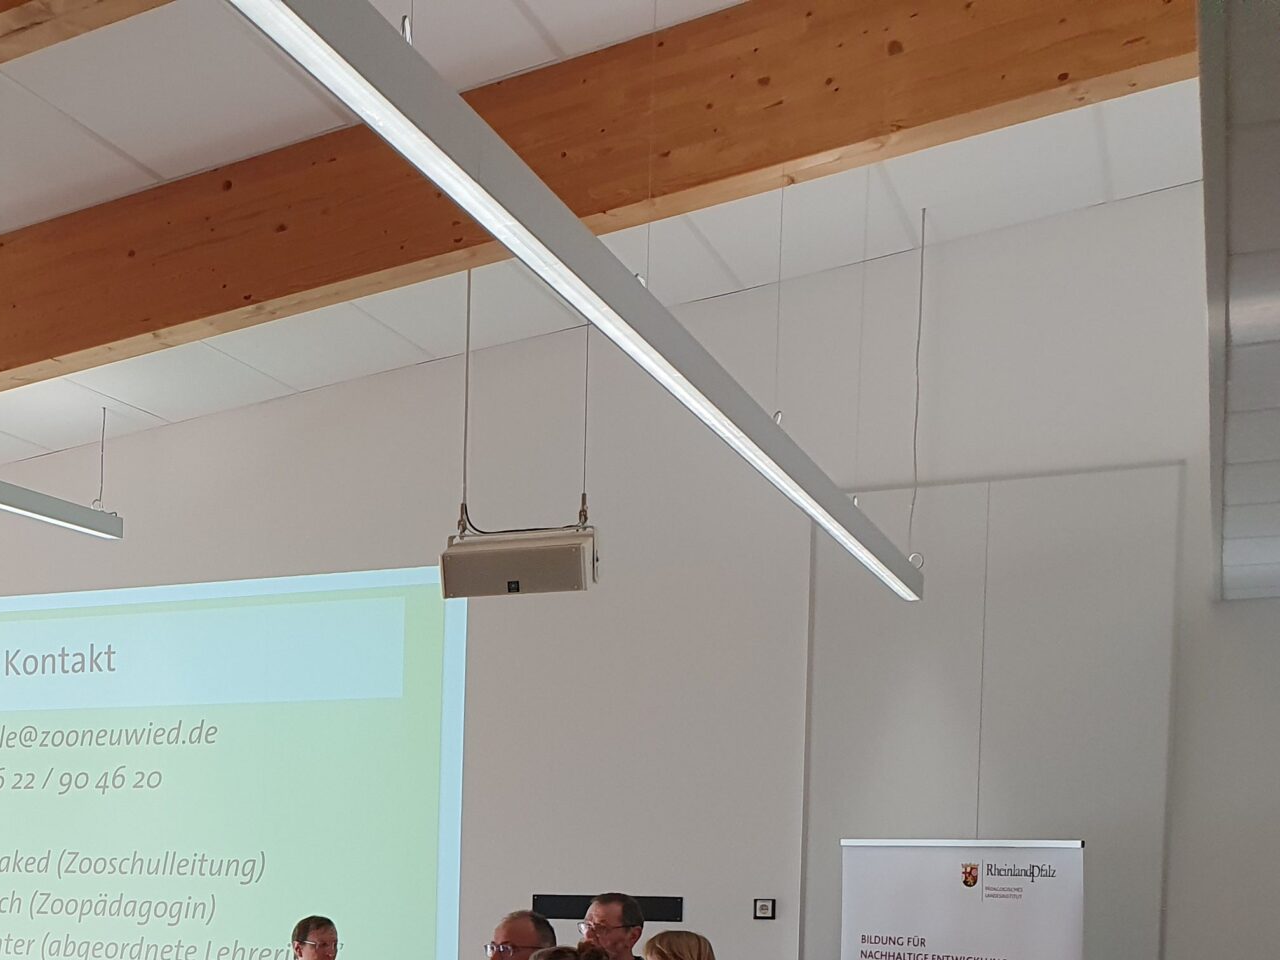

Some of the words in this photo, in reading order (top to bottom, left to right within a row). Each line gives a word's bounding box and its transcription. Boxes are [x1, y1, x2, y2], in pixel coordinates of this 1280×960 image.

[4, 643, 116, 677] Kontakt
[11, 772, 36, 790] 22
[41, 767, 55, 790] /
[58, 771, 89, 795] 90
[95, 765, 127, 795] 46
[132, 770, 162, 790] 20
[57, 848, 266, 886] (Zooschulleitung)
[29, 890, 216, 926] (Zoopädagogin)
[861, 934, 904, 947] BILDUNG
[907, 935, 926, 948] FÜR
